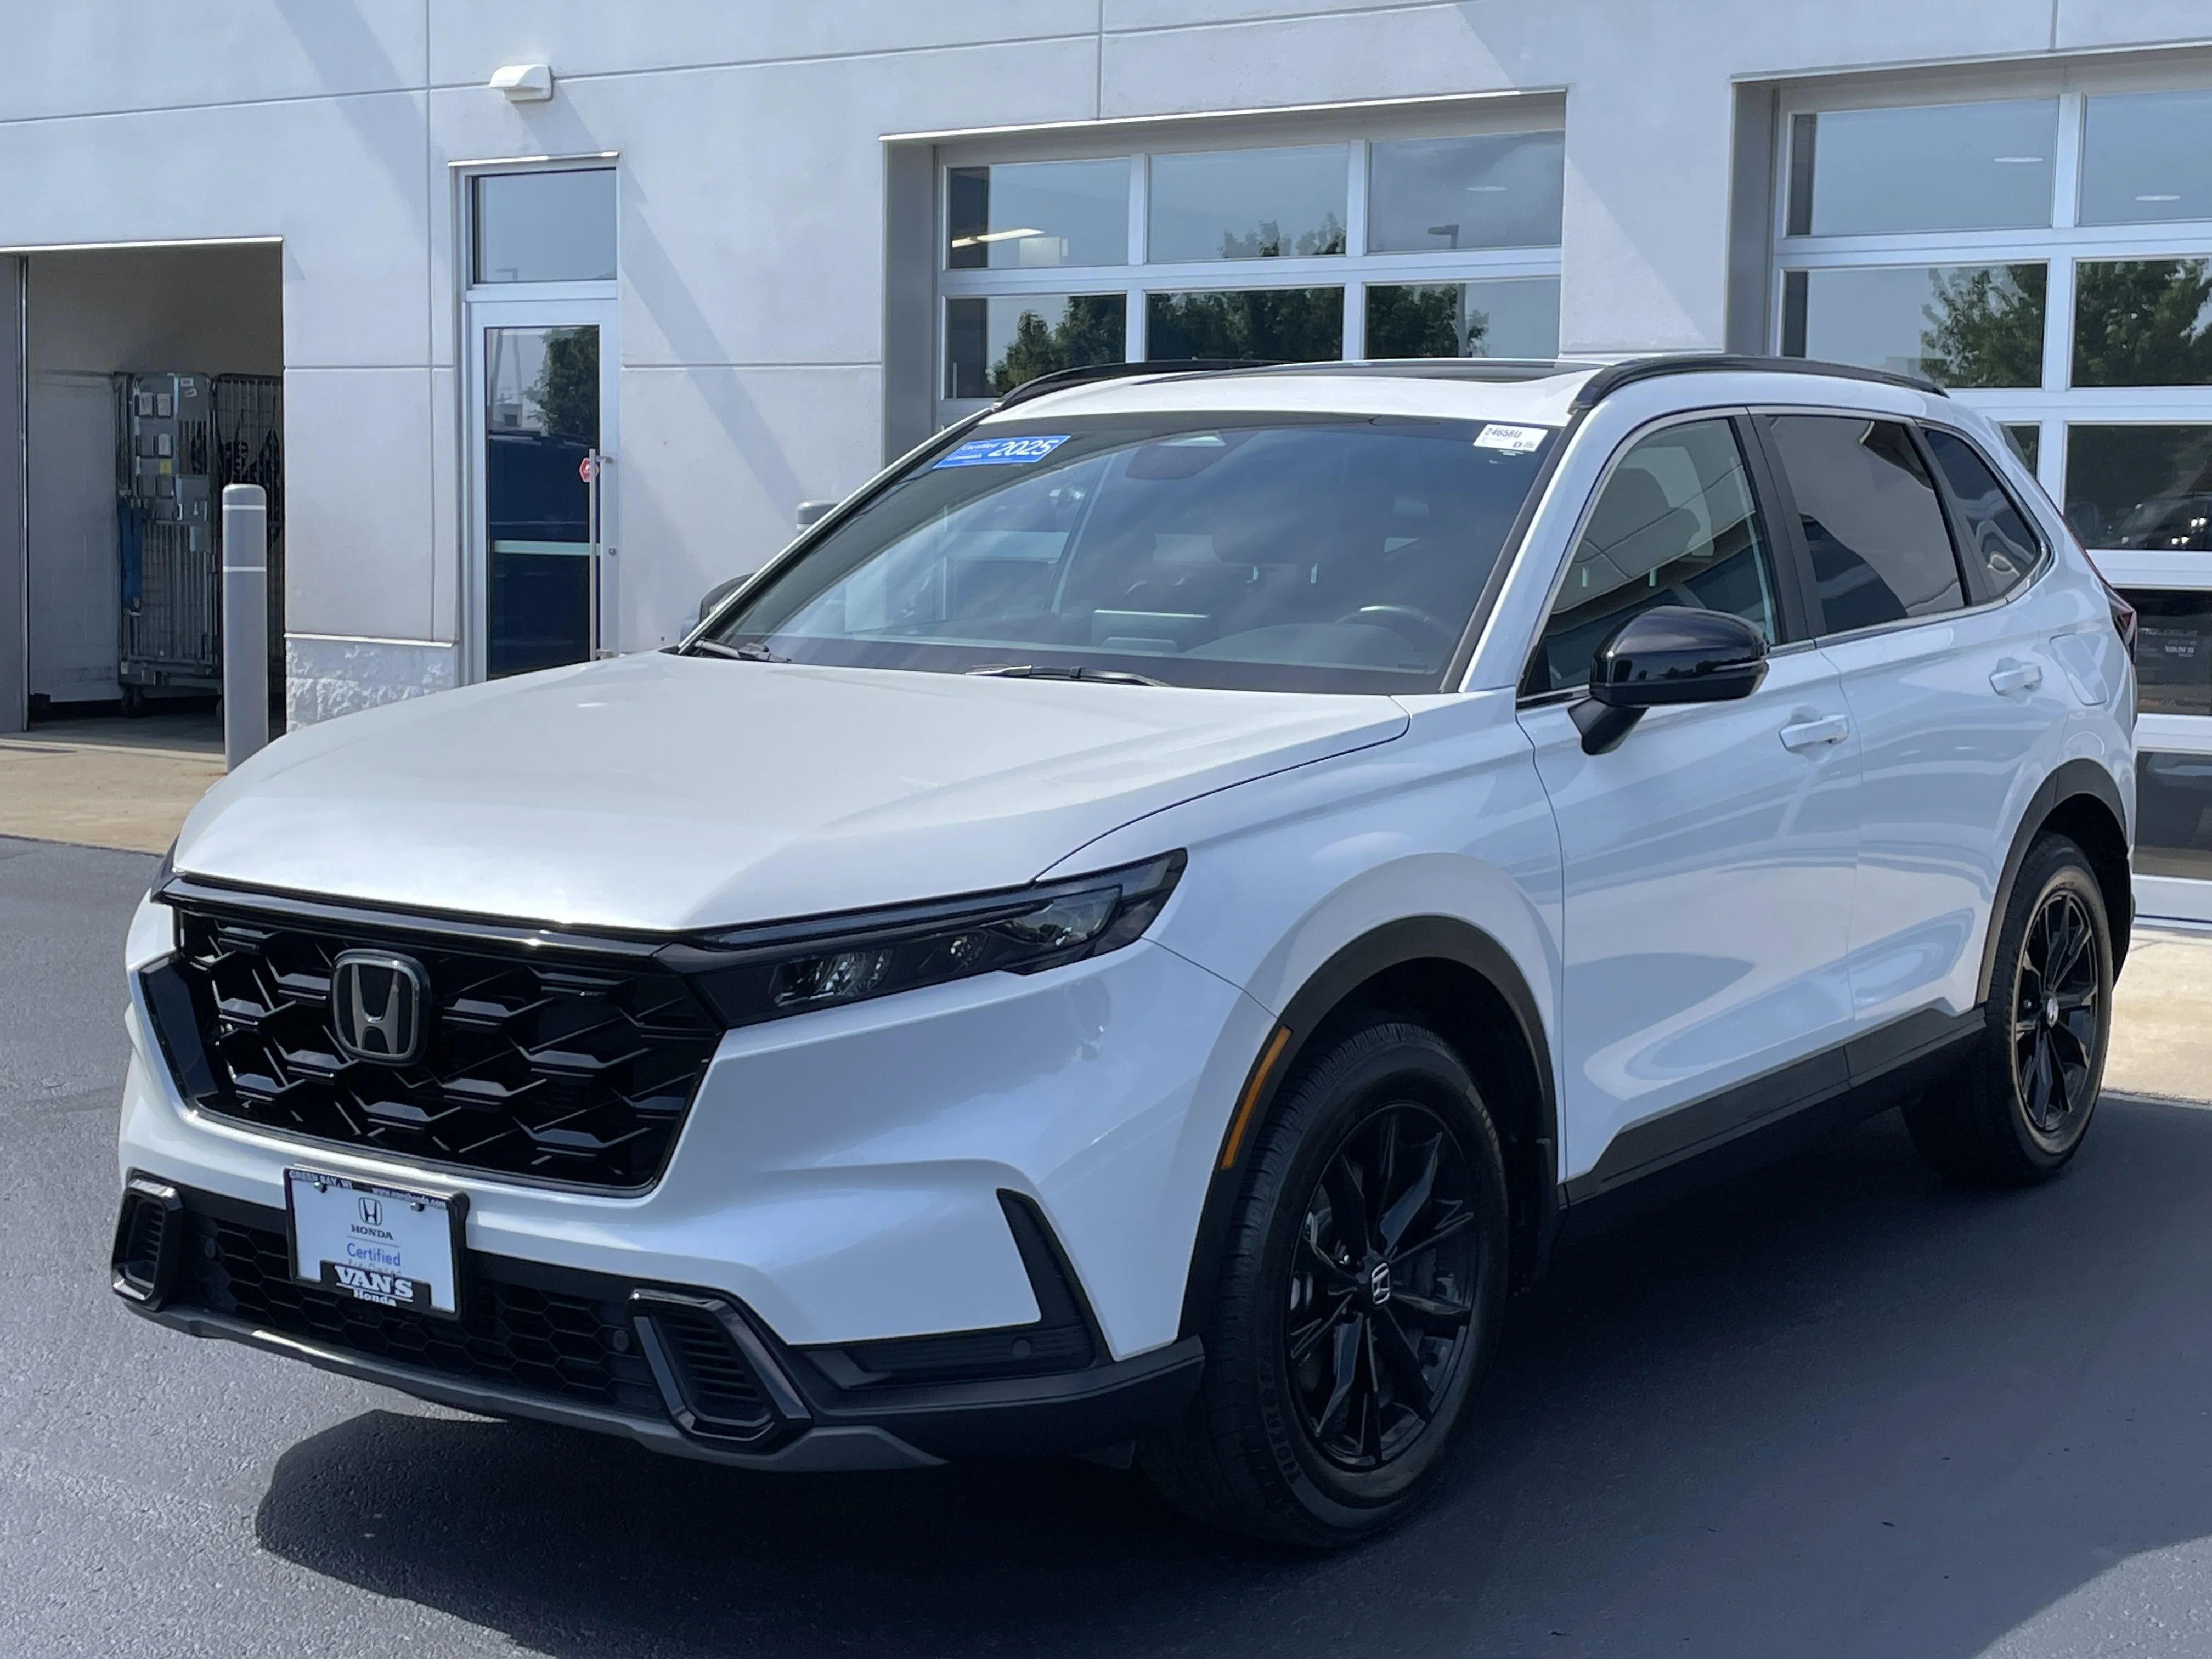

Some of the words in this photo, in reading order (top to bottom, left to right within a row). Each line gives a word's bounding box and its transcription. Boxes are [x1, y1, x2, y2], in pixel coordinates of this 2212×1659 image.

[988, 438, 1060, 456] 2025
[351, 1224, 394, 1240] HONDA
[347, 1243, 401, 1266] Certified
[353, 1288, 397, 1307] Honda
